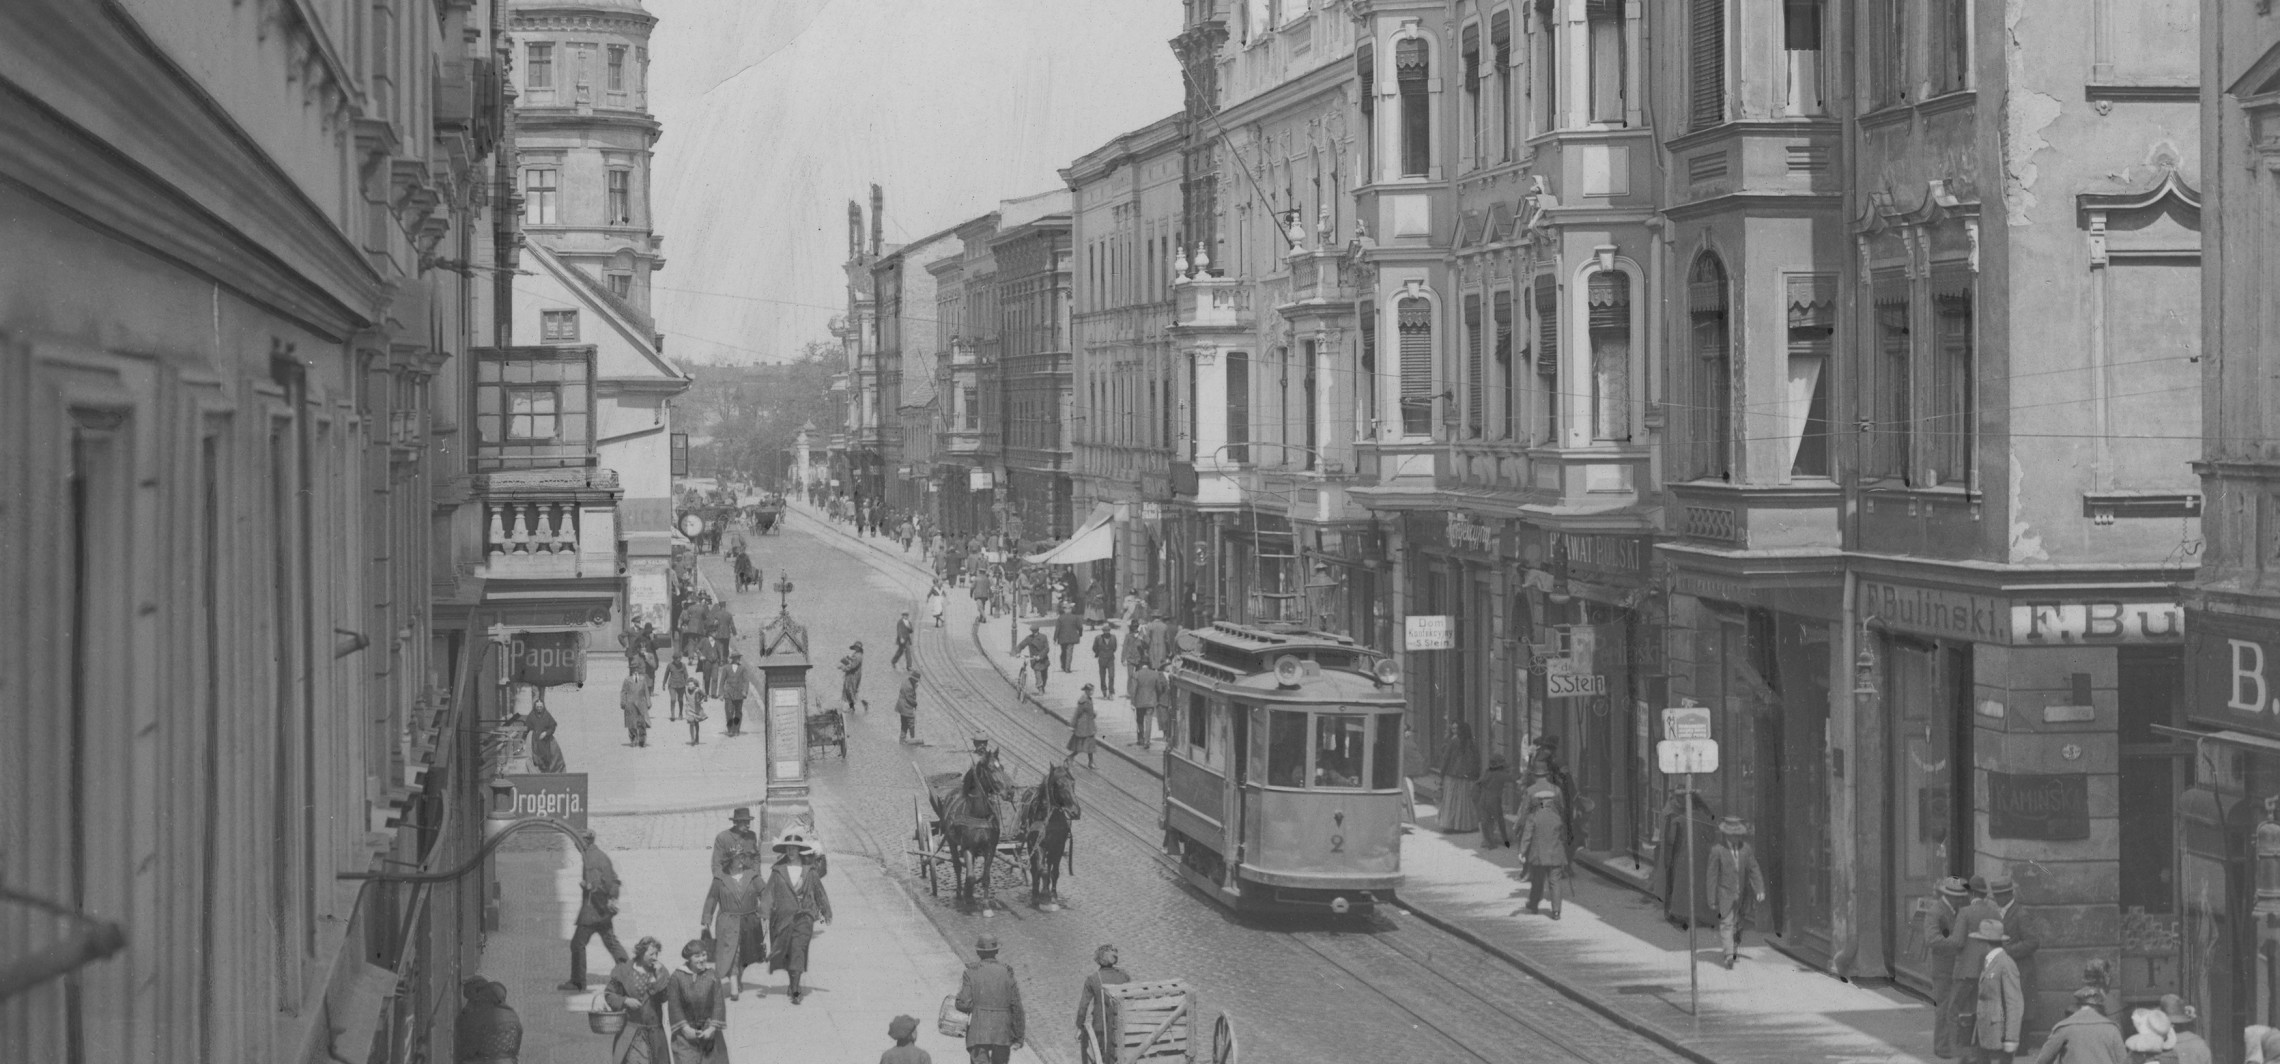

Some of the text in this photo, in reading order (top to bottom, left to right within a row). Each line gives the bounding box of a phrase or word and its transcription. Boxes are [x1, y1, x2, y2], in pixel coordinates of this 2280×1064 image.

[1596, 535, 1640, 570] POLSKI
[1418, 618, 1444, 627] Dom
[510, 640, 574, 676] Papie
[2227, 638, 2280, 716] B.
[1330, 834, 1344, 853] 2
